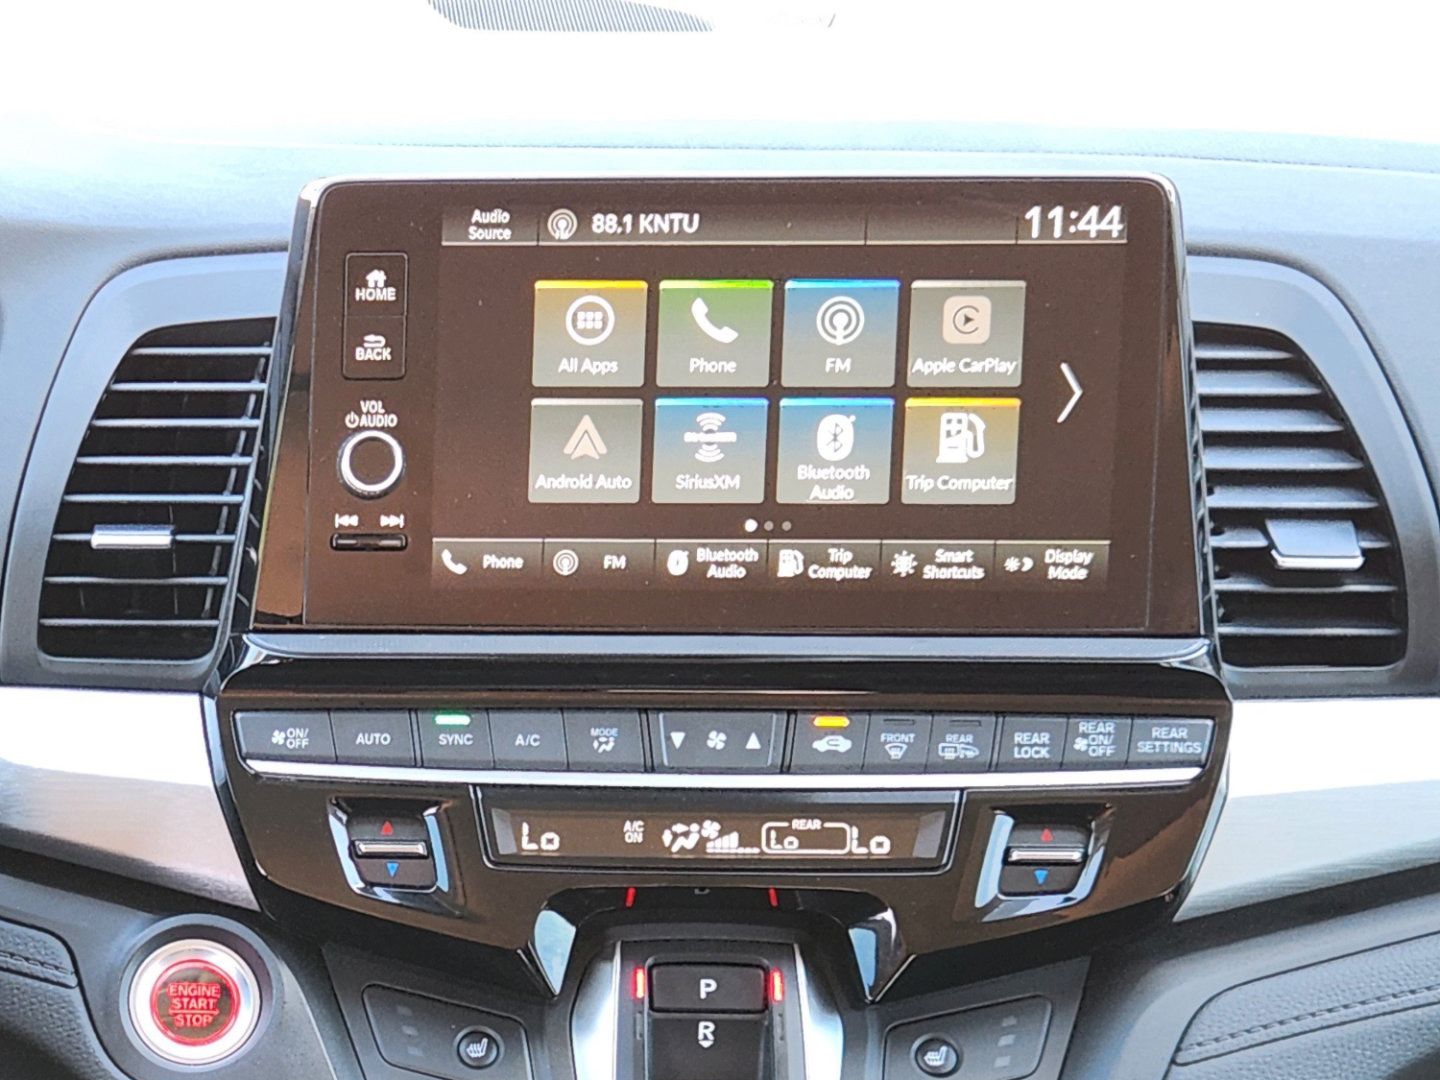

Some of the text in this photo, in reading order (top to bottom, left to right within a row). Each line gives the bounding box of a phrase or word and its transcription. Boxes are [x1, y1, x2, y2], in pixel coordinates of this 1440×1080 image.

[471, 208, 510, 224] Audio
[1025, 205, 1124, 238] 11:44
[592, 213, 700, 234] 88.1 KNTU
[468, 226, 512, 240] Source
[355, 287, 396, 301] HOME
[355, 347, 392, 360] BACK
[558, 358, 618, 375] All Apps
[689, 358, 737, 373] Phone
[825, 358, 852, 373] FM
[912, 358, 1017, 376] Apple CarPlay
[360, 401, 385, 414] VOL
[359, 414, 398, 427] AUDIO
[797, 465, 870, 480] Bluetooth
[535, 474, 632, 490] Android Auto
[675, 474, 740, 490] SiriusXM
[906, 475, 1013, 492] Trip Computer
[809, 485, 854, 500] Audio
[696, 547, 759, 562] Bluetooth
[828, 548, 853, 565] Trip
[935, 549, 974, 563] Smart
[1044, 549, 1094, 565] Display
[483, 555, 524, 570] Phone
[604, 555, 627, 569] FM
[707, 564, 747, 579] Audio
[808, 565, 873, 581] Computer
[923, 564, 985, 579] Shortcuts
[1047, 565, 1089, 580] Mode
[286, 728, 309, 739] ON/
[591, 728, 618, 737] MODE
[1079, 722, 1115, 733] REAR
[1152, 727, 1188, 739] REAR
[286, 738, 309, 749] OFF
[355, 733, 391, 745] AUTO
[438, 733, 474, 746] SYNC
[515, 734, 541, 747] A/C
[880, 733, 915, 743] FRONT
[946, 734, 973, 743] REAR
[1014, 732, 1050, 745] REAR
[1088, 734, 1114, 745] ON/
[1014, 747, 1050, 759] LOCK
[1088, 745, 1116, 757] OFF
[1137, 742, 1201, 754] SETTINGS
[623, 820, 645, 832] A/C
[791, 819, 822, 830] REAR
[624, 832, 643, 843] ON
[169, 983, 221, 998] ENGINE
[700, 979, 718, 999] P
[171, 998, 218, 1010] START
[175, 1014, 213, 1027] STOP
[697, 1022, 715, 1039] R
